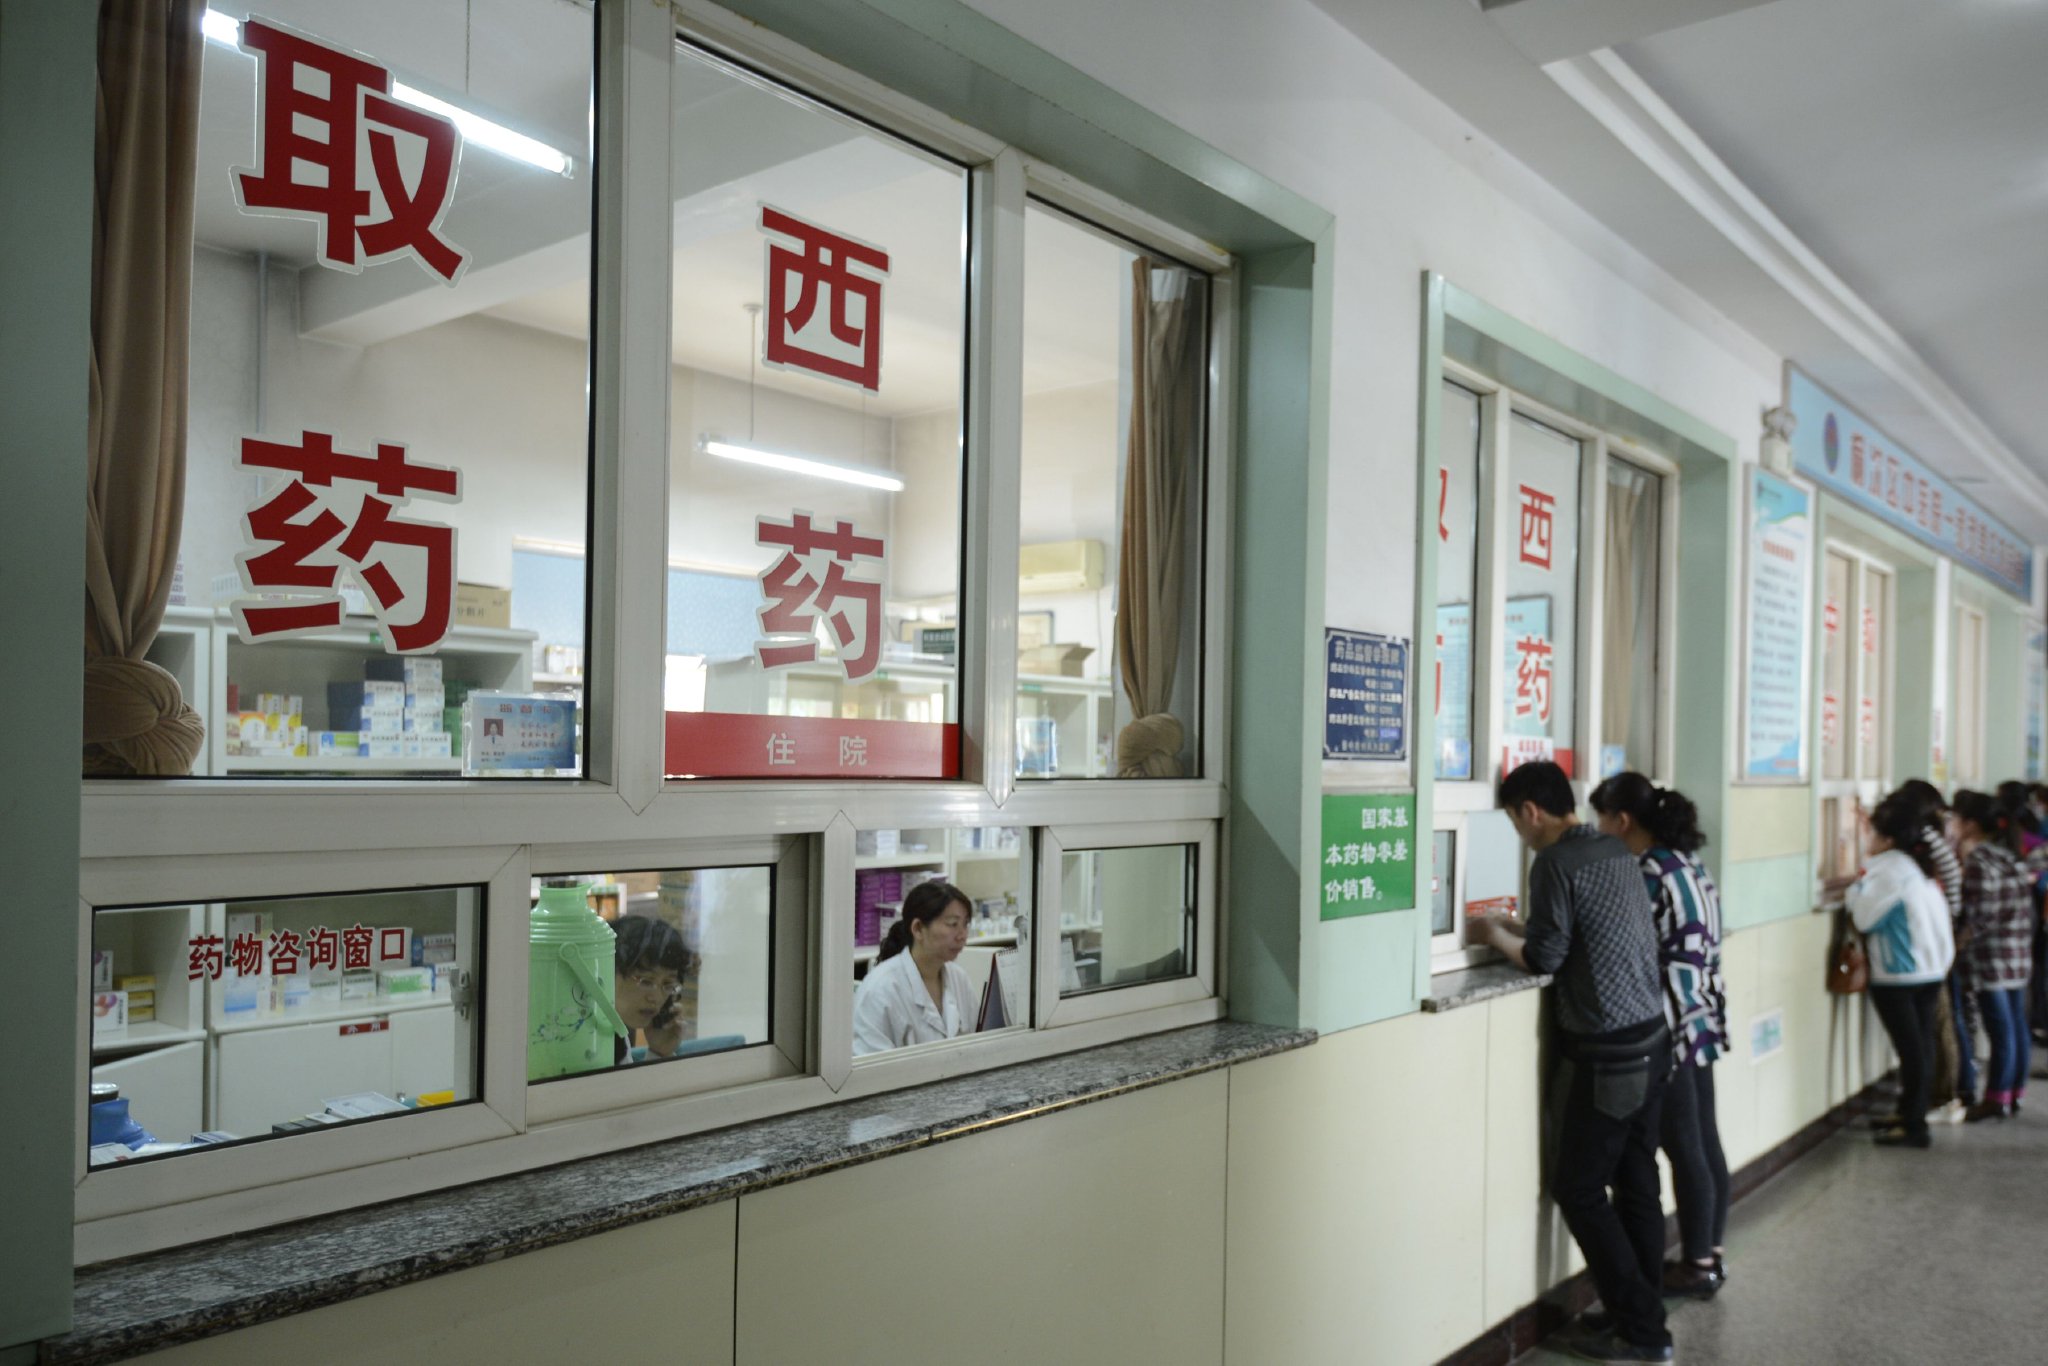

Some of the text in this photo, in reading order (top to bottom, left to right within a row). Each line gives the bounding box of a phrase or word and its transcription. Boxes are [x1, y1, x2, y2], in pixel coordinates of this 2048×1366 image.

[239, 20, 464, 652] 取药
[759, 207, 889, 678] 西药
[1516, 484, 1556, 721] 西药
[766, 733, 868, 766] 住院
[1361, 807, 1408, 829] 国家基
[1325, 838, 1408, 867] 本药物零差
[188, 926, 406, 981] 药物咨询窗口
